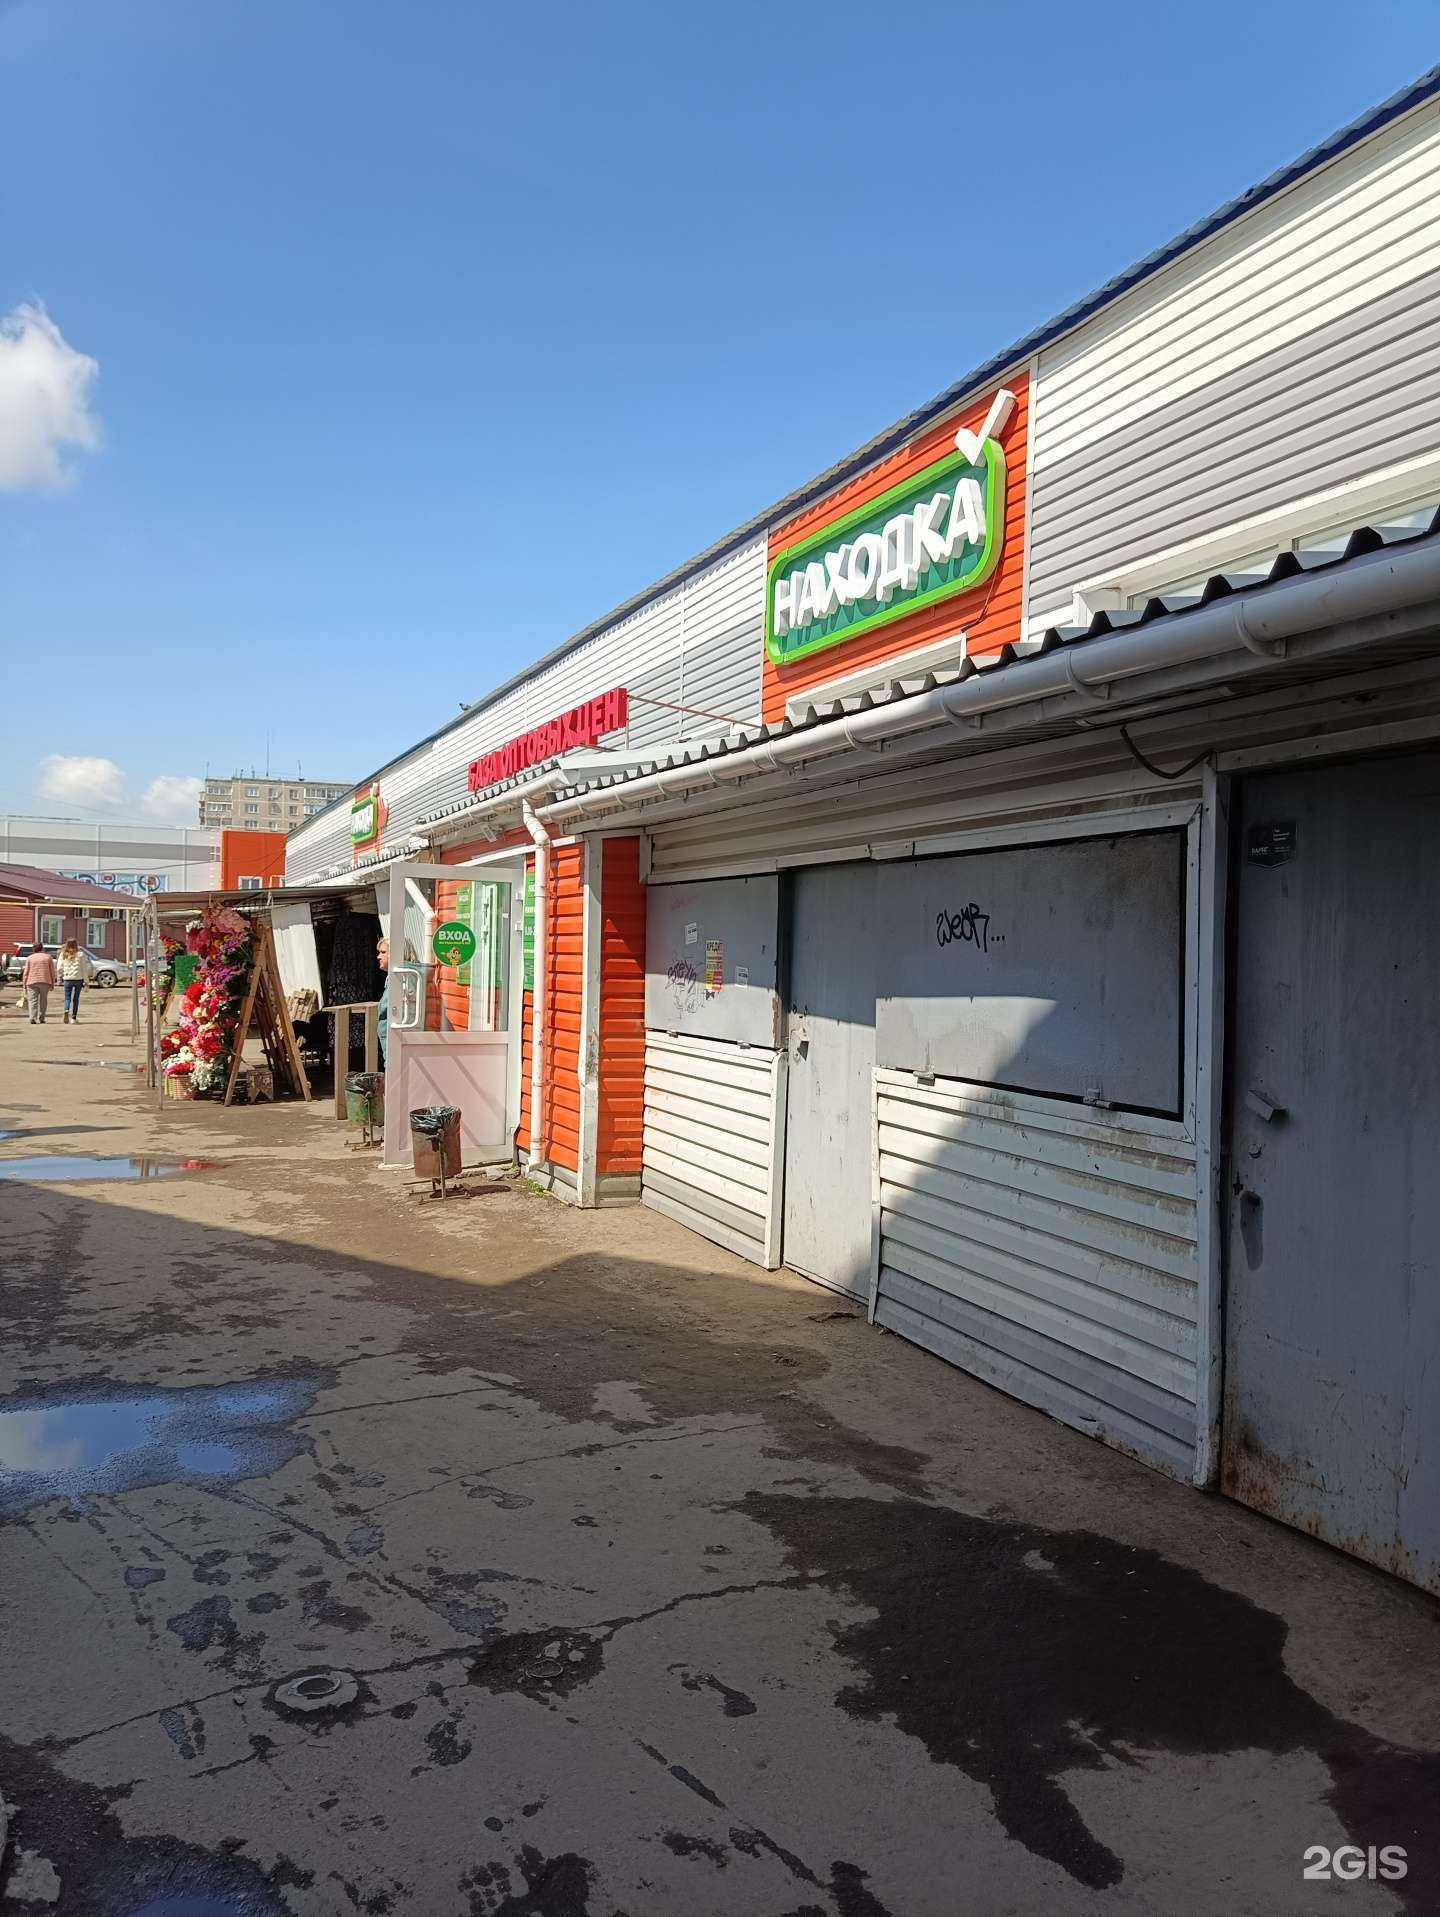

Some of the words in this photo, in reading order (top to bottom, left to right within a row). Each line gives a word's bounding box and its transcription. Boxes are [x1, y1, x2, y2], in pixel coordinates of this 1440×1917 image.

[773, 477, 986, 636] НАХОДКА
[468, 751, 500, 792] БАЗА
[501, 711, 575, 779] ОПТОВЫХ
[576, 687, 627, 746] ЦЕН
[438, 930, 471, 942] ВХОД
